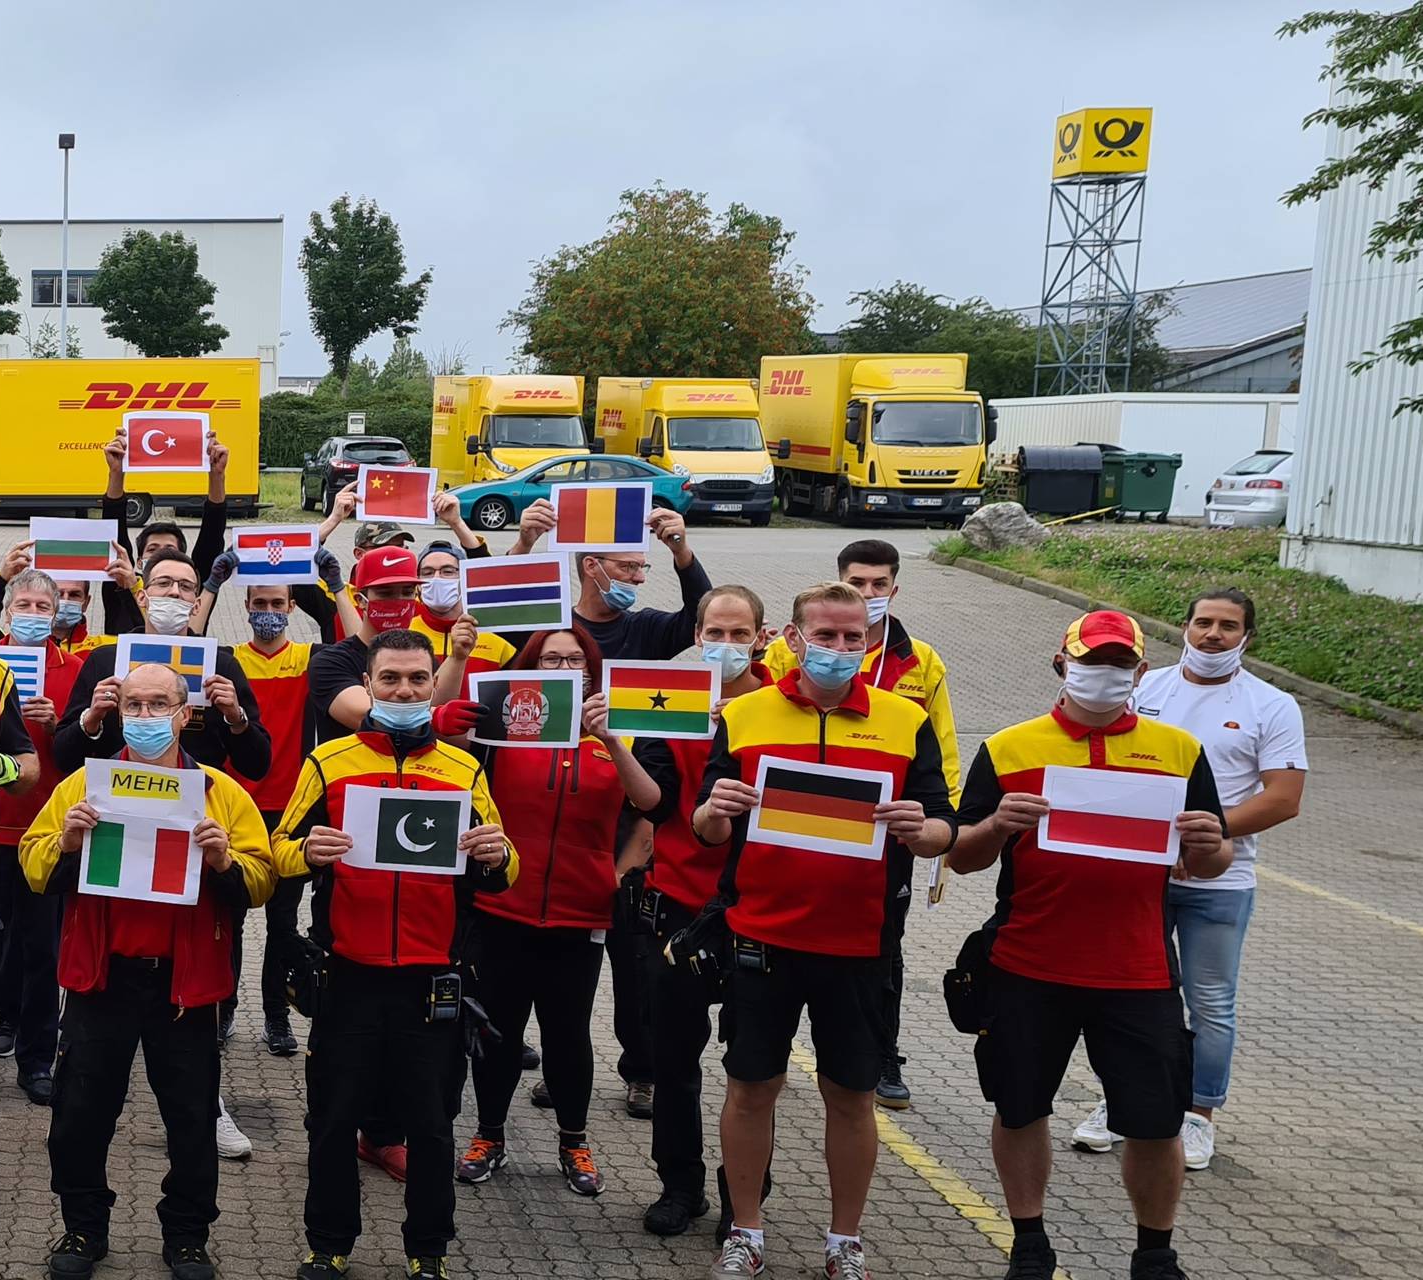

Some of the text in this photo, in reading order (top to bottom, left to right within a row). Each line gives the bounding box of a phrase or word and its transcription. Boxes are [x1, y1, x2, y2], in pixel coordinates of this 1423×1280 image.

[770, 370, 805, 395] DHL
[83, 383, 216, 409] DHL
[514, 390, 563, 399] DHL
[686, 393, 738, 402] DHL
[601, 408, 625, 430] DHL
[910, 469, 948, 477] IVECO
[897, 683, 925, 692] DHL
[1128, 753, 1158, 761] DHL
[414, 763, 444, 776] DHL
[112, 773, 180, 793] MEHR
